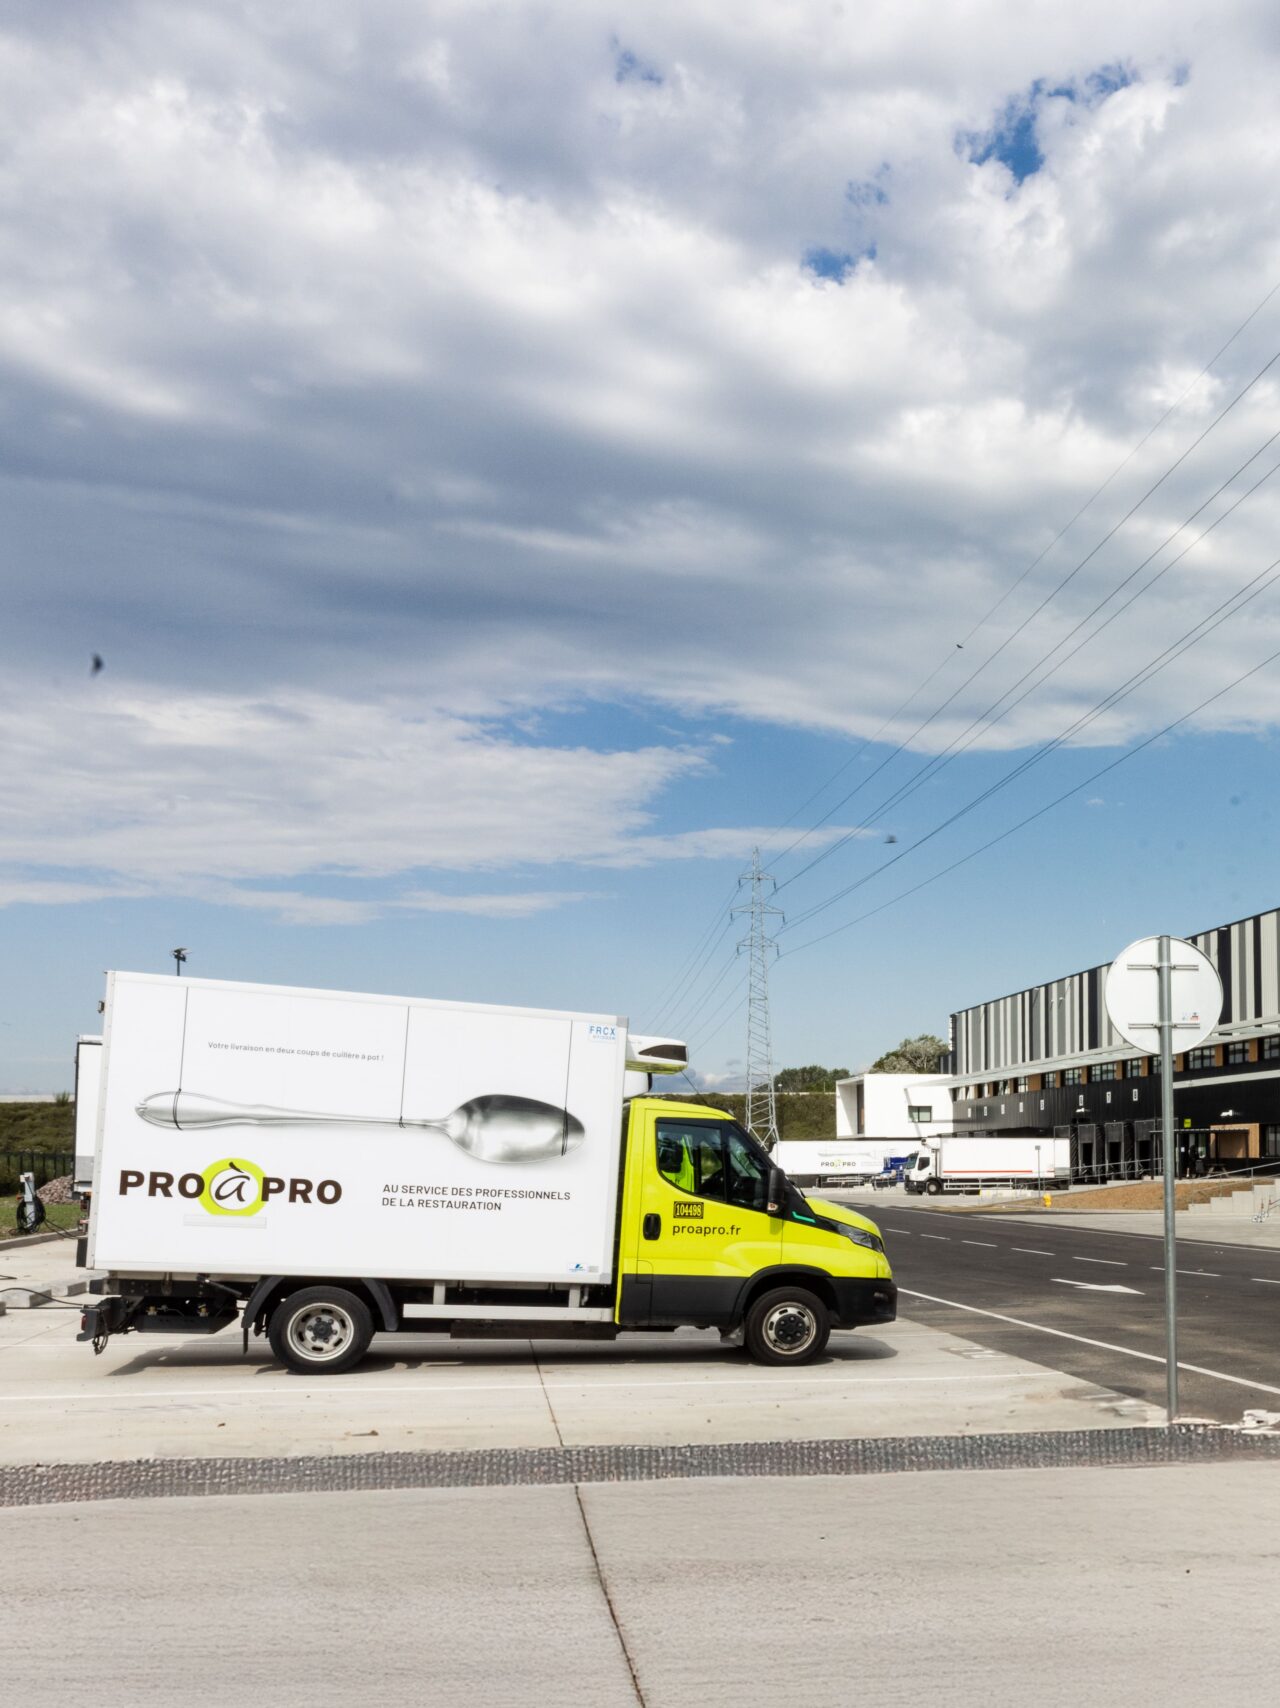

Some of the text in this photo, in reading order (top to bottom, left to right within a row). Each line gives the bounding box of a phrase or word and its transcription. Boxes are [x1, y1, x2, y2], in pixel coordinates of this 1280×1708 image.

[589, 1025, 616, 1036] FRCX
[207, 1041, 229, 1050] Votre
[230, 1042, 264, 1052] livraison
[276, 1046, 295, 1054] deux
[296, 1048, 320, 1057] coups
[321, 1049, 331, 1057] de
[367, 1053, 380, 1061] pot
[119, 1169, 205, 1200] PRO
[261, 1177, 342, 1205] PRO
[382, 1183, 571, 1201] AU SERVICE DES PROFESSIONNELS
[381, 1197, 502, 1211] DE LA RESTAURATION
[676, 1204, 702, 1216] 104498
[672, 1224, 741, 1237] proapro.fr
